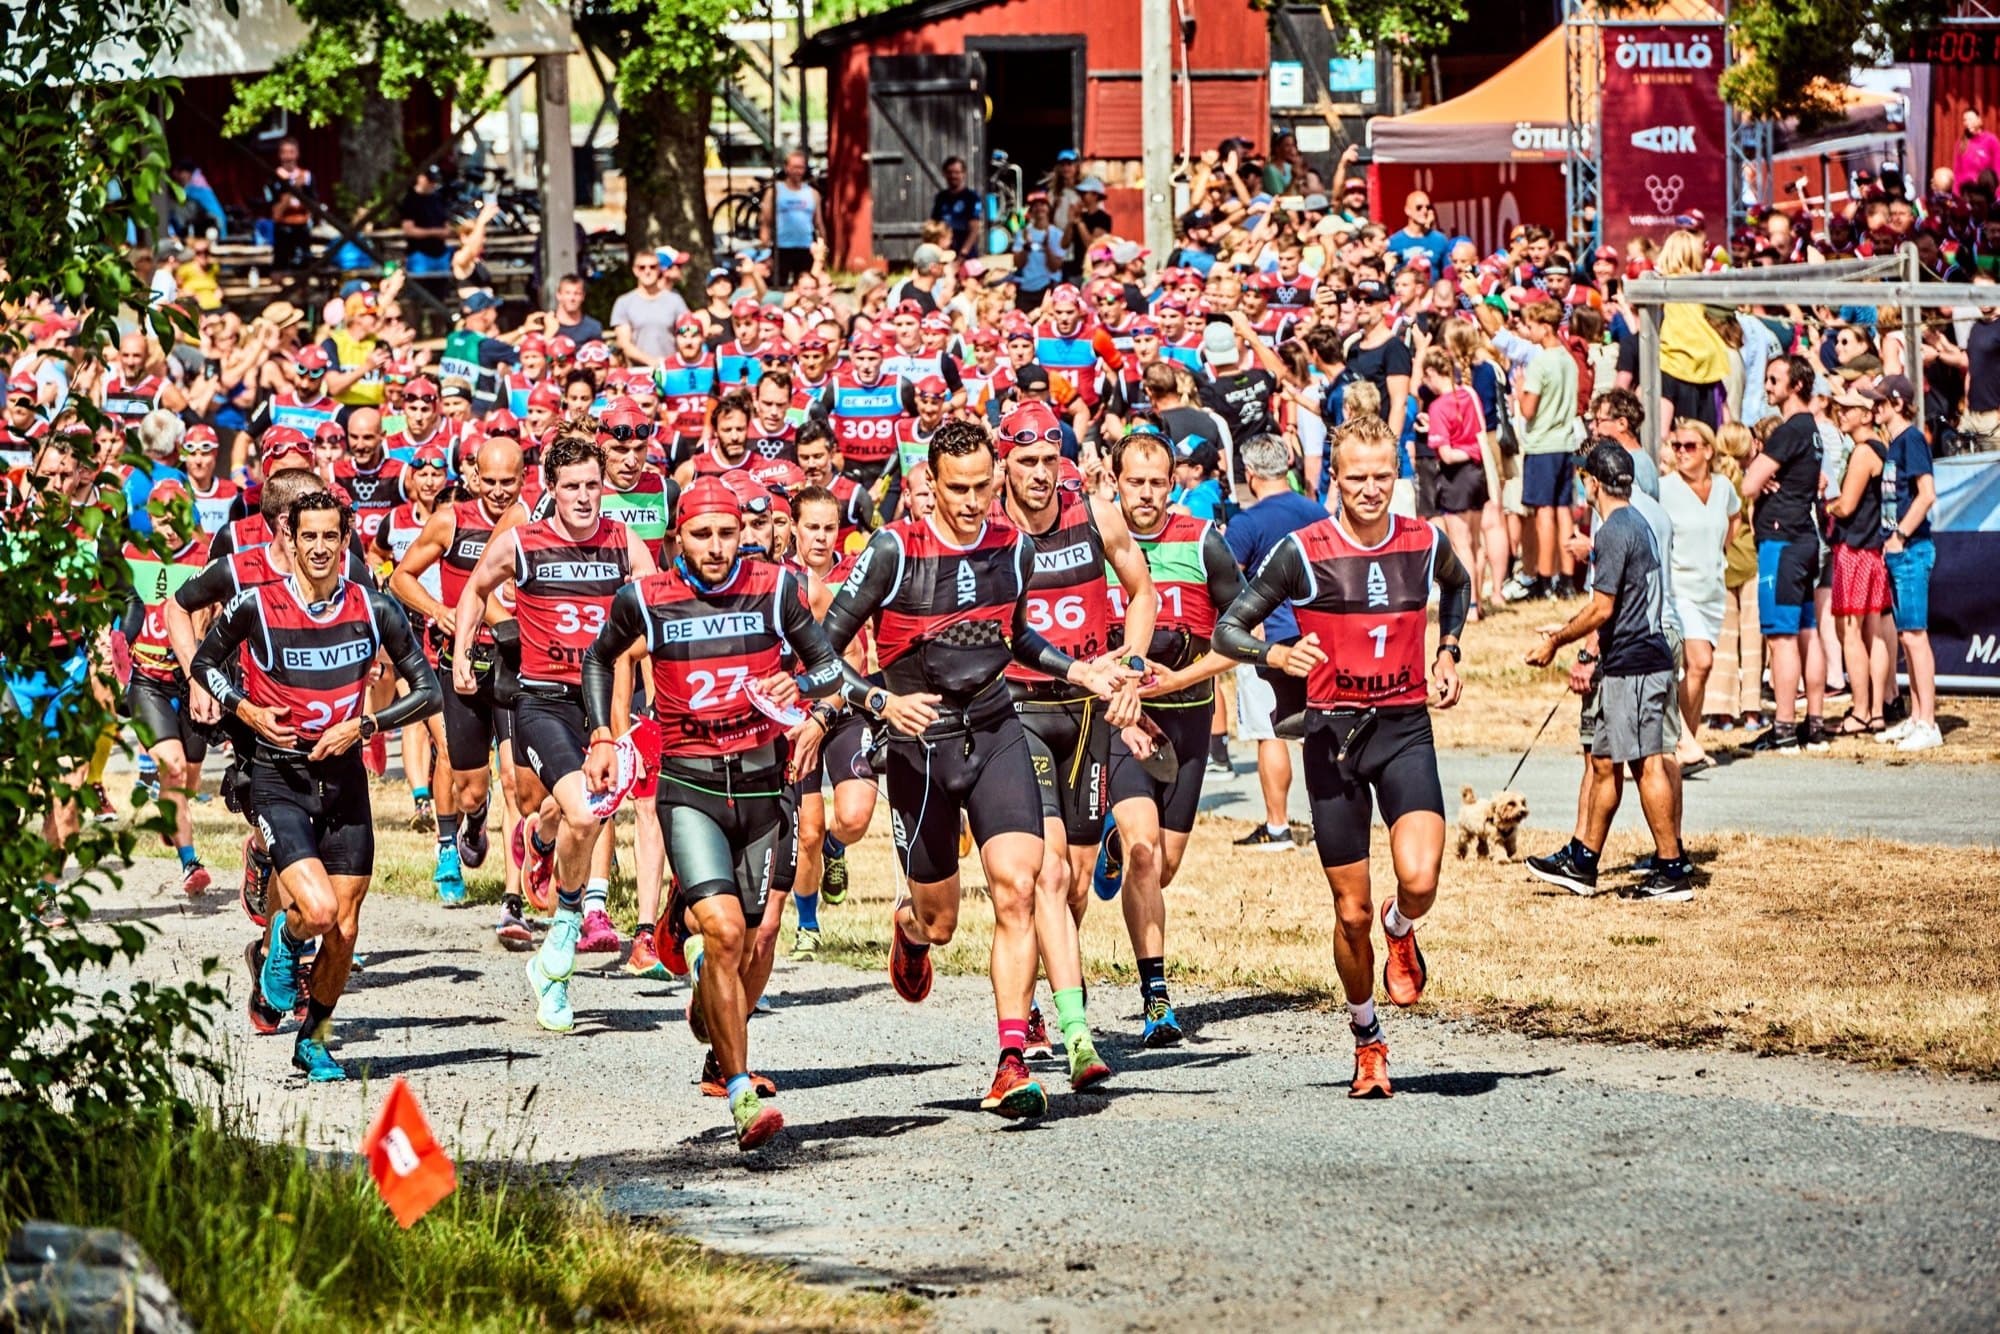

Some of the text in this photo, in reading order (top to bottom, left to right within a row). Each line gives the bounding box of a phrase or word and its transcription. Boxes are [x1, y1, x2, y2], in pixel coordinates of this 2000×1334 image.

[1615, 34, 1713, 69] ÖTILLÖ
[1631, 126, 1697, 153] ARK
[843, 418, 893, 440] 309
[620, 509, 655, 522] WTR
[461, 543, 485, 557] BE
[1037, 546, 1087, 568] WTR
[155, 568, 168, 599] ARK
[538, 564, 616, 579] BE WTR
[842, 545, 876, 599] ARK
[957, 559, 977, 606] ARK
[1367, 561, 1390, 608] ARK
[554, 602, 606, 635] 33
[1027, 595, 1086, 632] 36
[1106, 586, 1183, 618] 11
[666, 615, 758, 639] BE WTR
[1367, 624, 1388, 659] 1
[286, 642, 369, 668] BE WTR
[206, 668, 234, 705] ARK
[685, 666, 749, 710] 27
[809, 659, 843, 686] HEA
[1335, 664, 1412, 692] ÖTILLÖ
[301, 692, 361, 731] 27
[1088, 762, 1101, 820] HEAD
[892, 807, 909, 851] ARK
[757, 848, 773, 905] HEAD
